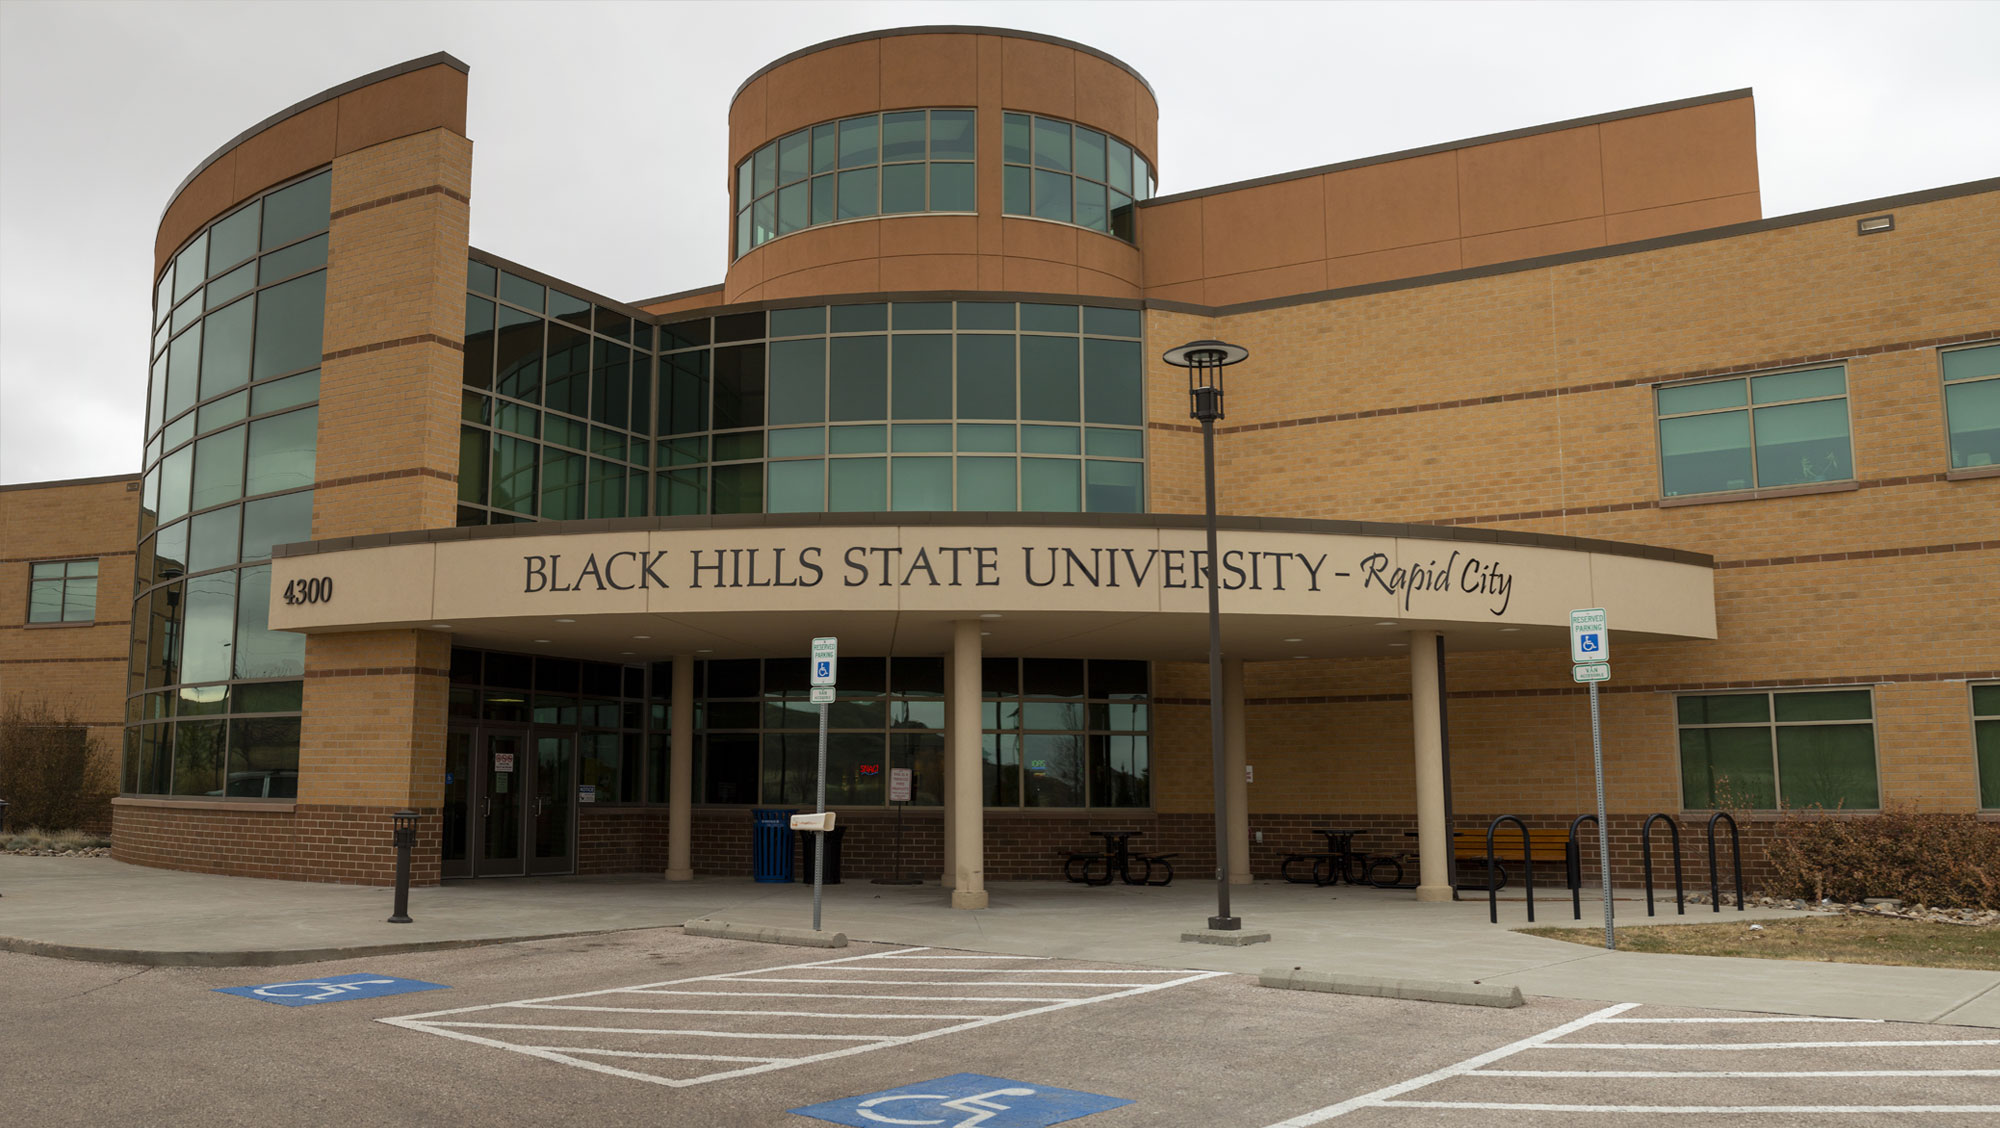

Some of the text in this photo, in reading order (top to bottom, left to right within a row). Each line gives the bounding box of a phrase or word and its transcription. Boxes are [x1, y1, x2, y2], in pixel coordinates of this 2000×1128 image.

[523, 551, 670, 593] BLACK
[689, 546, 824, 588] HILLS
[844, 546, 1000, 587] STATE
[1021, 546, 1327, 592] UNIVERSITY
[1359, 550, 1460, 612] Rapid
[1460, 558, 1513, 616] City
[283, 576, 333, 605] 4300
[1573, 615, 1603, 623] RESERVED
[1575, 624, 1602, 632] PARKING
